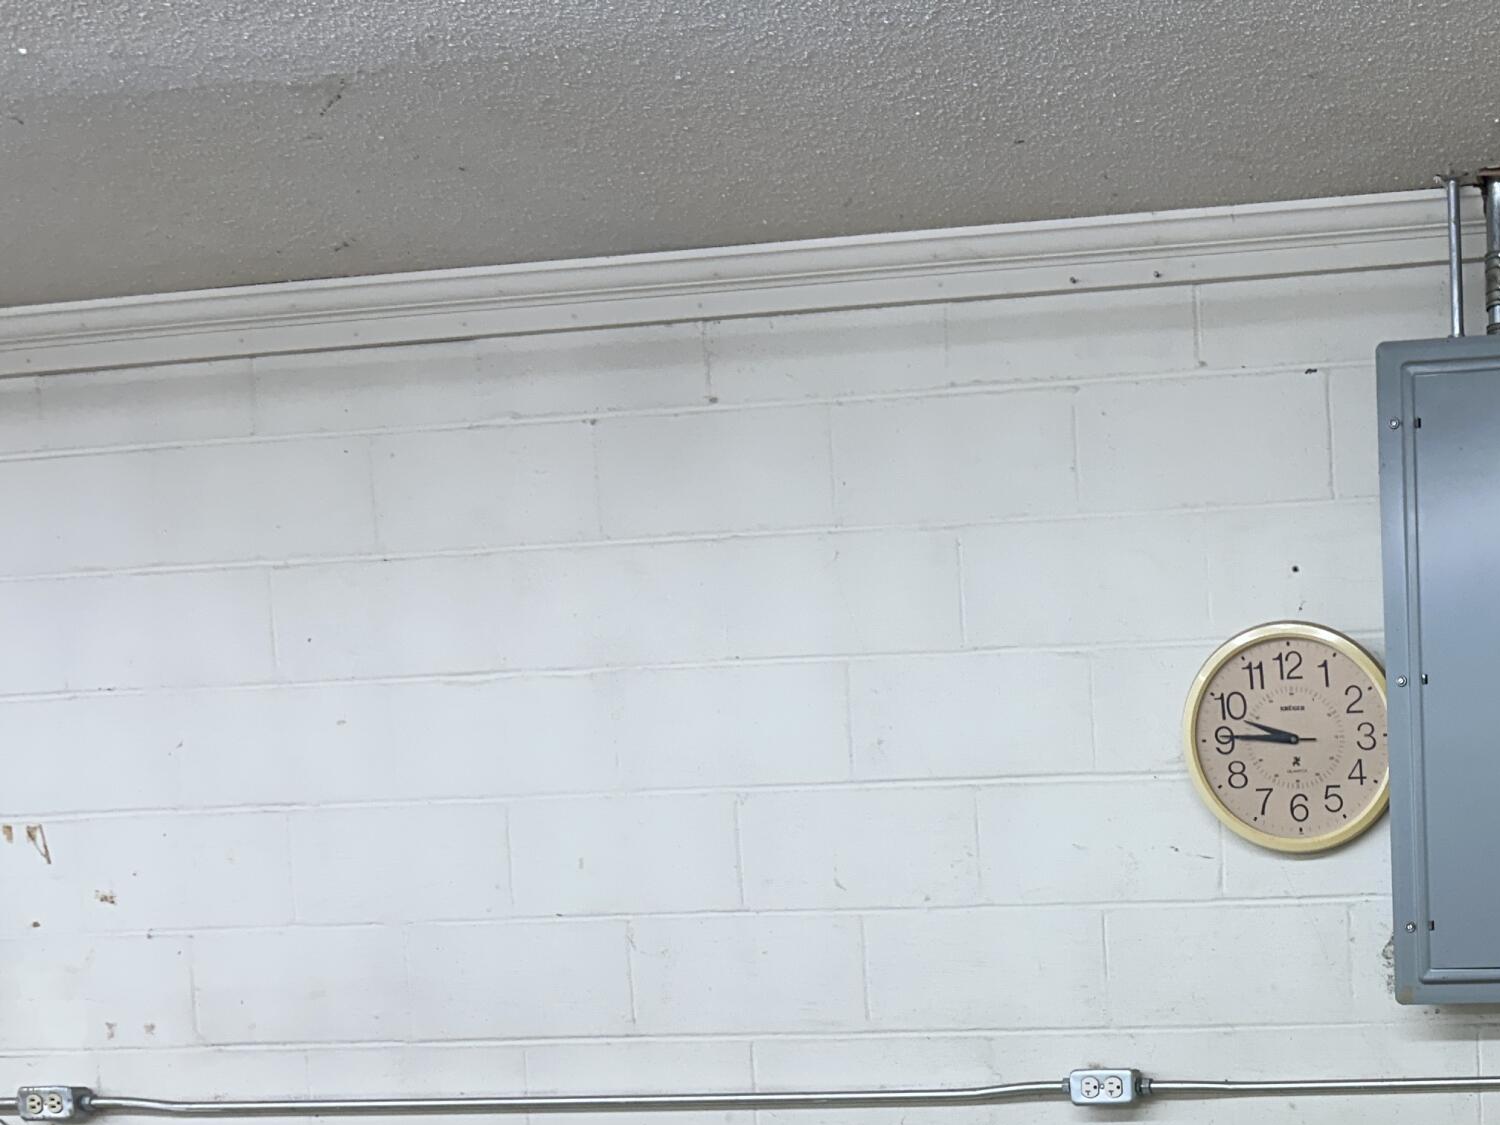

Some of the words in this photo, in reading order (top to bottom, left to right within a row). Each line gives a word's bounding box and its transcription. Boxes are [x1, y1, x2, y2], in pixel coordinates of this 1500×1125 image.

[1242, 661, 1265, 690] 11
[1272, 650, 1303, 680] 12
[1317, 659, 1330, 688] 1
[1214, 691, 1247, 720] 10
[1344, 685, 1364, 714] 2
[1214, 726, 1235, 755] 9
[1356, 722, 1377, 751] 3
[1227, 760, 1248, 789] 8
[1348, 758, 1367, 786] 4
[1255, 788, 1274, 816] 7
[1290, 793, 1309, 822] 6
[1324, 785, 1343, 813] 5
